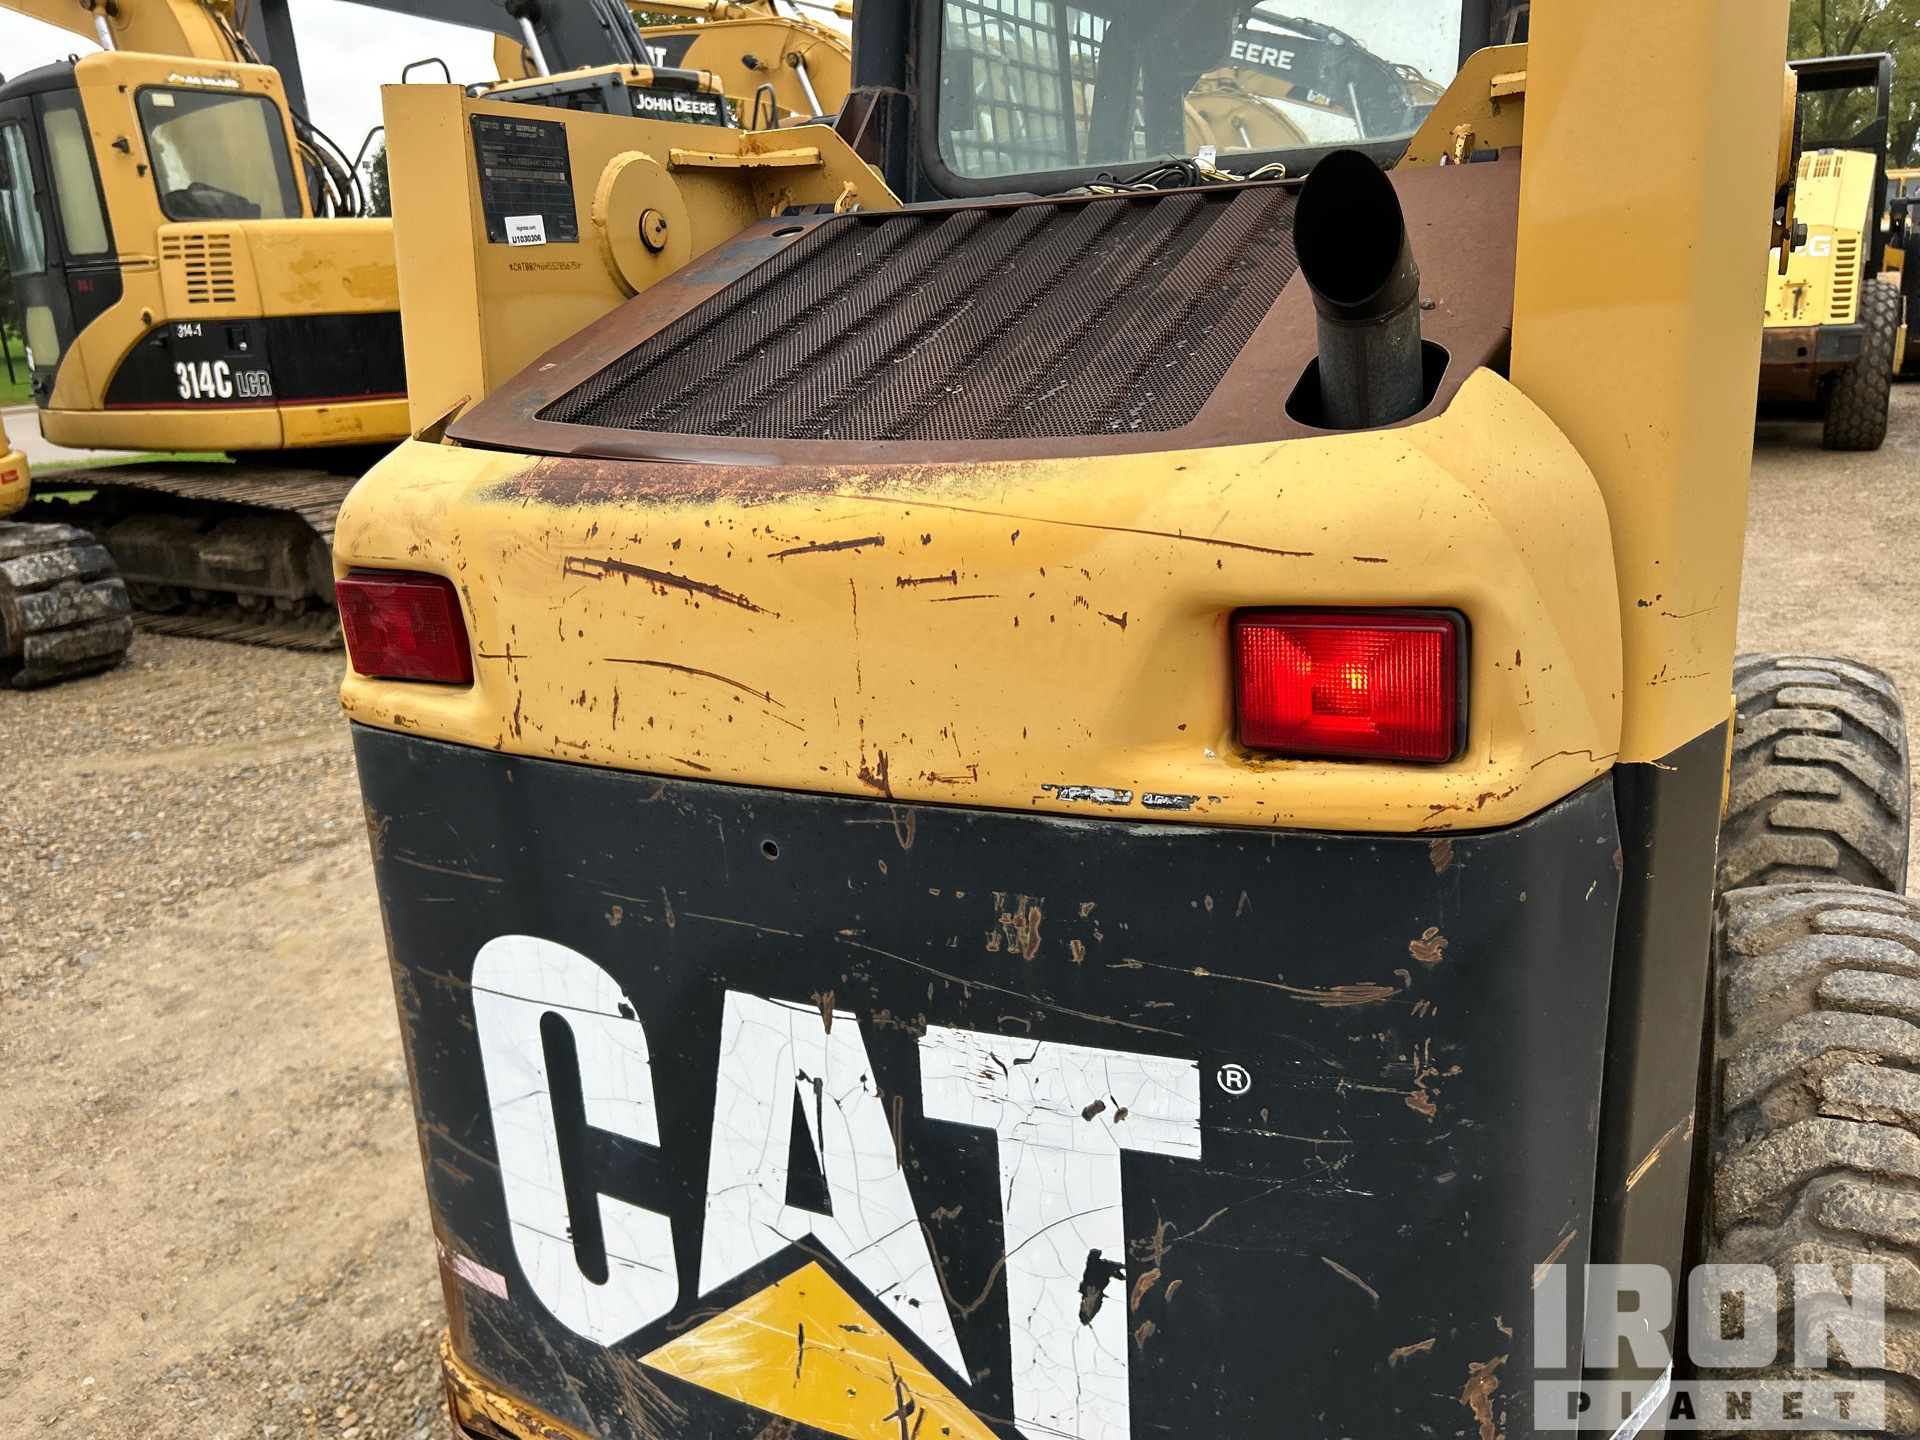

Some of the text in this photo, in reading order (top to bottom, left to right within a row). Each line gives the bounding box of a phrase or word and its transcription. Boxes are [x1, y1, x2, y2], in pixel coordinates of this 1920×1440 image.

[1230, 40, 1295, 70] EERE
[636, 93, 717, 116] JOHN DEERE
[511, 233, 542, 244] U1030306
[177, 323, 203, 338] 314-1
[175, 360, 273, 400] 314C LCR
[472, 934, 1202, 1440] CAT
